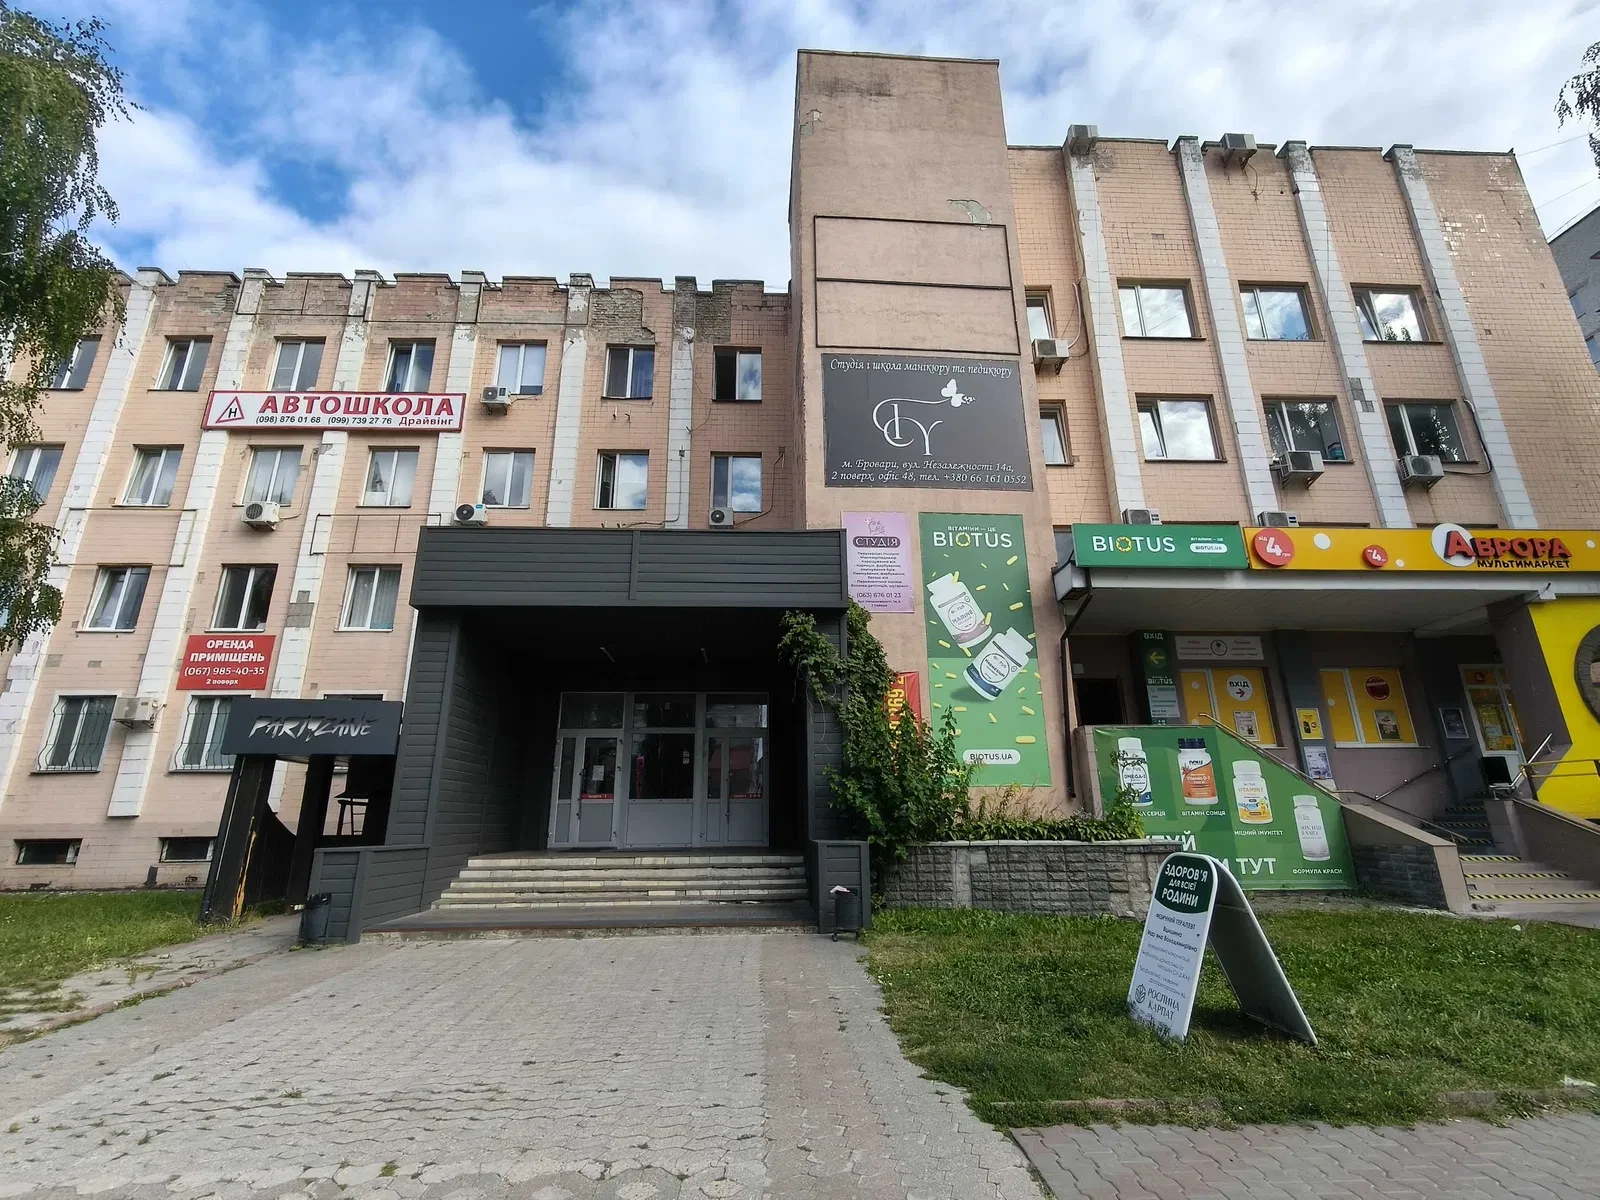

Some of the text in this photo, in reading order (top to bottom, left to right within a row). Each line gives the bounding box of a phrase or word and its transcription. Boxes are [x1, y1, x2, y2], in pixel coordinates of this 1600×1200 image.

[830, 358, 1012, 378] Студія і школа манікюру та педикюру
[259, 395, 454, 415] АВТОШКОЛА
[256, 416, 277, 424] (098)
[328, 417, 349, 425] (099)
[399, 417, 454, 426] Драйвінг
[856, 459, 899, 470] Бровари,
[902, 462, 920, 471] вул.
[923, 460, 993, 472] Незалежності
[996, 463, 1014, 473] 14а,
[831, 471, 837, 479] 2
[840, 472, 875, 482] поверх,
[878, 470, 899, 482] офіс
[902, 472, 916, 481] 48,
[944, 473, 967, 482] +380
[970, 474, 981, 482] 66
[985, 474, 1001, 483] 161
[1004, 475, 1027, 484] 0552
[855, 538, 898, 547] СТУДІЯ
[933, 532, 1013, 548] BIOTUS
[1092, 536, 1176, 552] BIOTUS
[1266, 537, 1282, 556] 4
[1445, 531, 1572, 558] АВРОРА
[1477, 560, 1570, 568] МУЛЬТИМАРКЕТ
[1144, 632, 1163, 640] ВХІД
[206, 640, 254, 650] ОРЕНДА
[190, 653, 265, 663] ПРИМІЩЕНЬ
[184, 667, 265, 676] (067) 985-40-35
[1229, 680, 1250, 688] ВХІД
[1165, 863, 1208, 882] ЗДОРОВ'Я
[1236, 858, 1276, 874] ТУТ
[1169, 879, 1197, 890] ДЛЯ ВСІЄЇ
[1162, 887, 1199, 907] РОДИНИ
[1148, 988, 1179, 1011] РОСЛИНА
[1148, 1000, 1175, 1020] КАРПАТ
